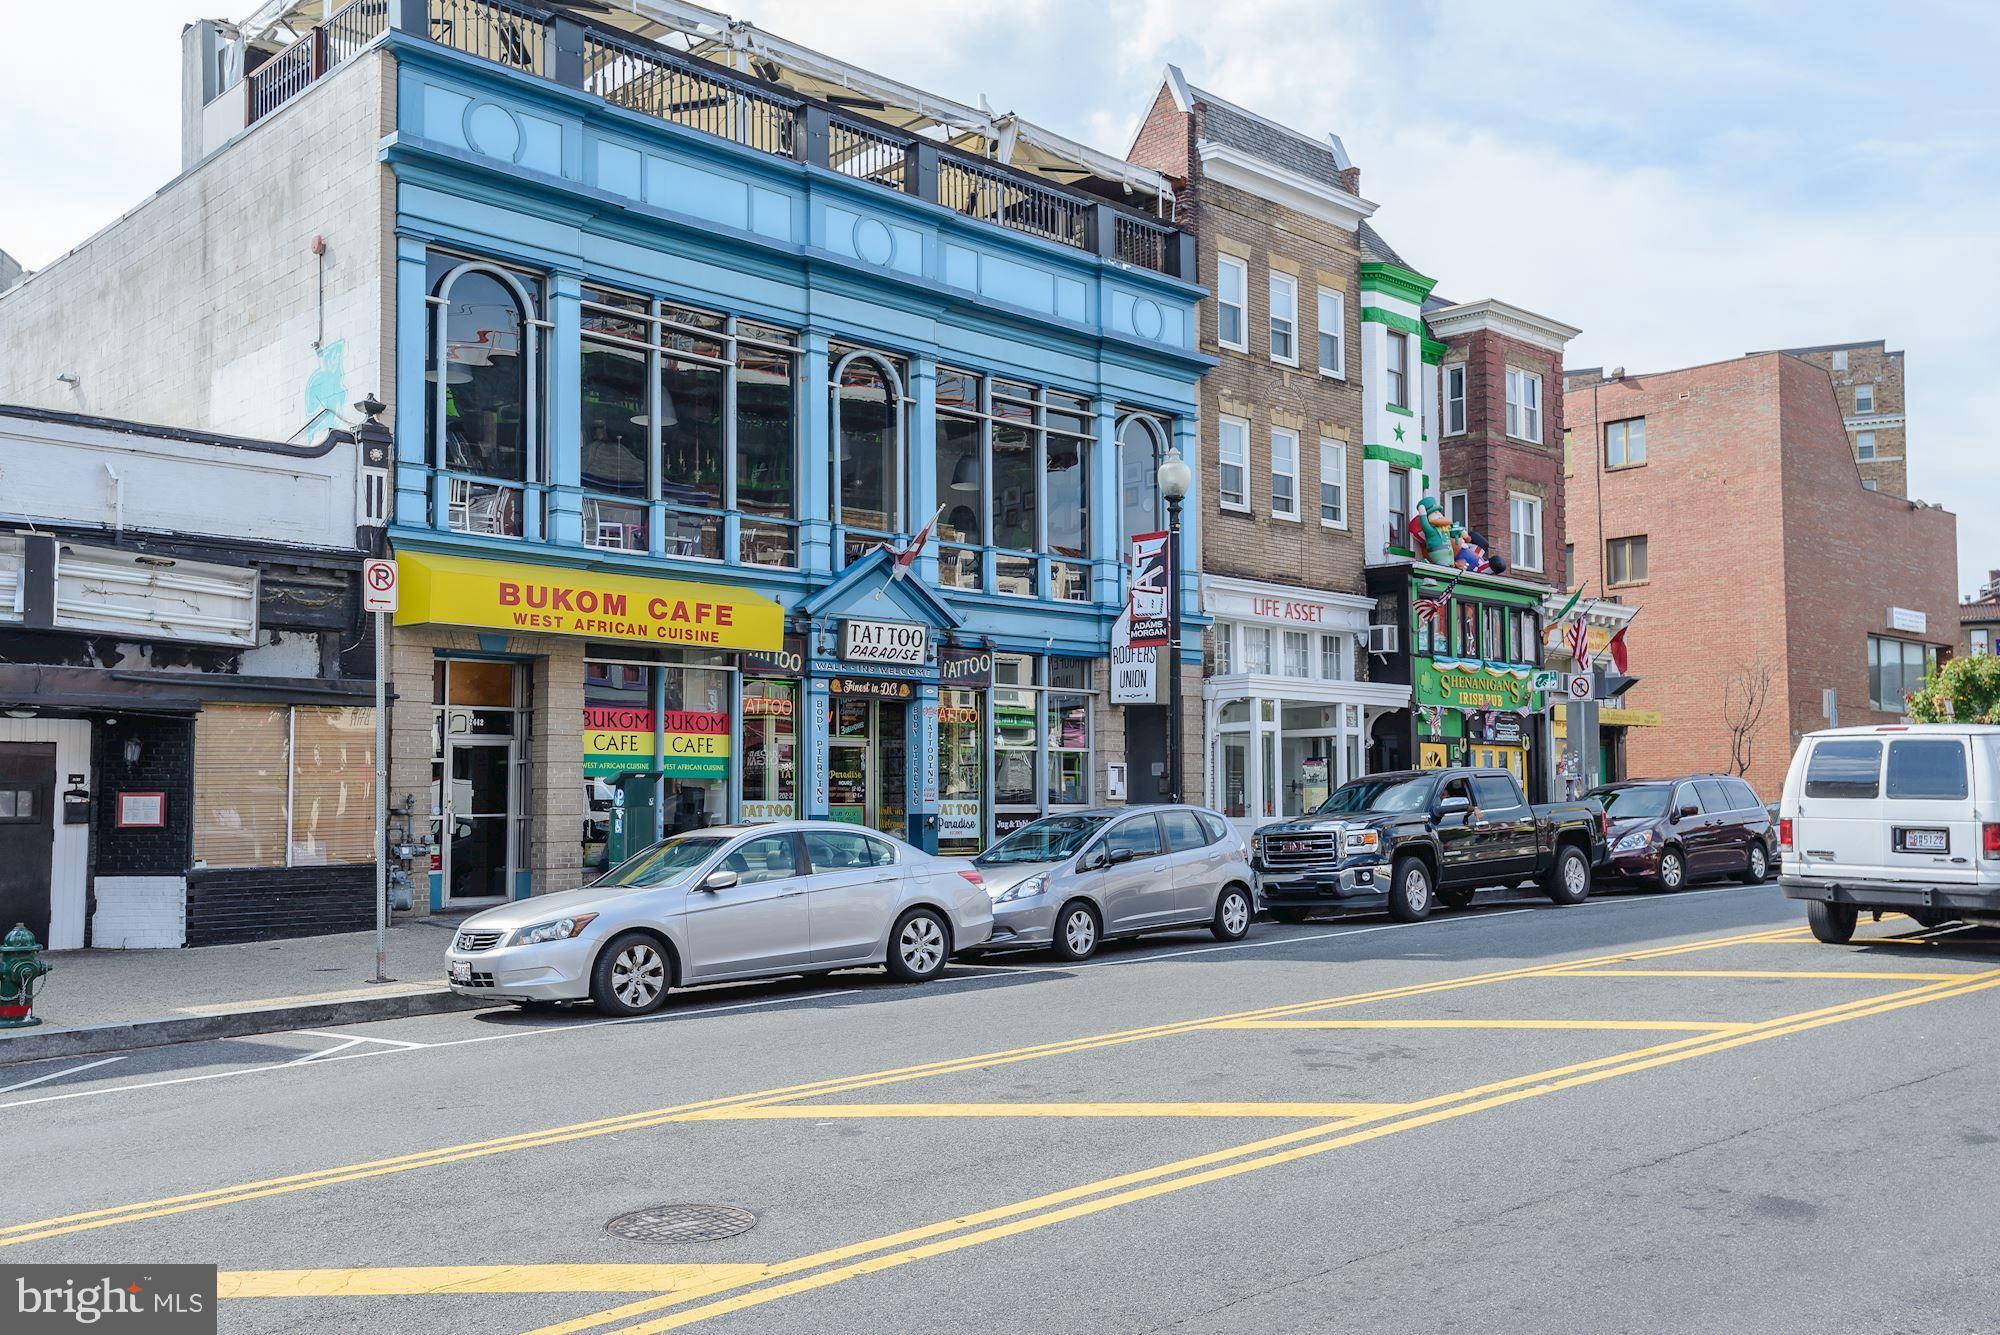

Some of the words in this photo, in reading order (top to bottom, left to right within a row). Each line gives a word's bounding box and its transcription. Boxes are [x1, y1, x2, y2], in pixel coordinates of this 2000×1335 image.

[499, 582, 627, 617] BUKOM
[648, 598, 733, 627] CAFE
[1253, 597, 1280, 618] LIFE
[1285, 602, 1324, 622] ASSET
[513, 612, 564, 628] WEST
[574, 618, 648, 637] AFRICAN
[656, 626, 720, 643] CUISINE
[1130, 627, 1167, 639] MORGAN
[1133, 620, 1164, 631] ADAMS
[849, 624, 924, 648] TATTOO
[849, 645, 921, 661] PARADISE
[1112, 646, 1157, 665] ROOFERS
[879, 666, 932, 677] WELCOME
[1119, 669, 1147, 688] UNION
[843, 679, 871, 694] Finest
[871, 682, 880, 693] in
[1440, 674, 1520, 704] SHENANIGANS
[1459, 691, 1484, 706] IRISH
[1485, 693, 1503, 707] PUB
[816, 700, 824, 731] BODY
[593, 734, 638, 752] CAFE
[672, 736, 714, 754] CAFE
[599, 762, 626, 770] AFRICAN
[702, 764, 725, 772] CUISINE
[816, 740, 824, 804] PIERCING
[829, 770, 863, 780] Paradise
[937, 817, 977, 832] Paradise
[1281, 840, 1313, 852] GMC
